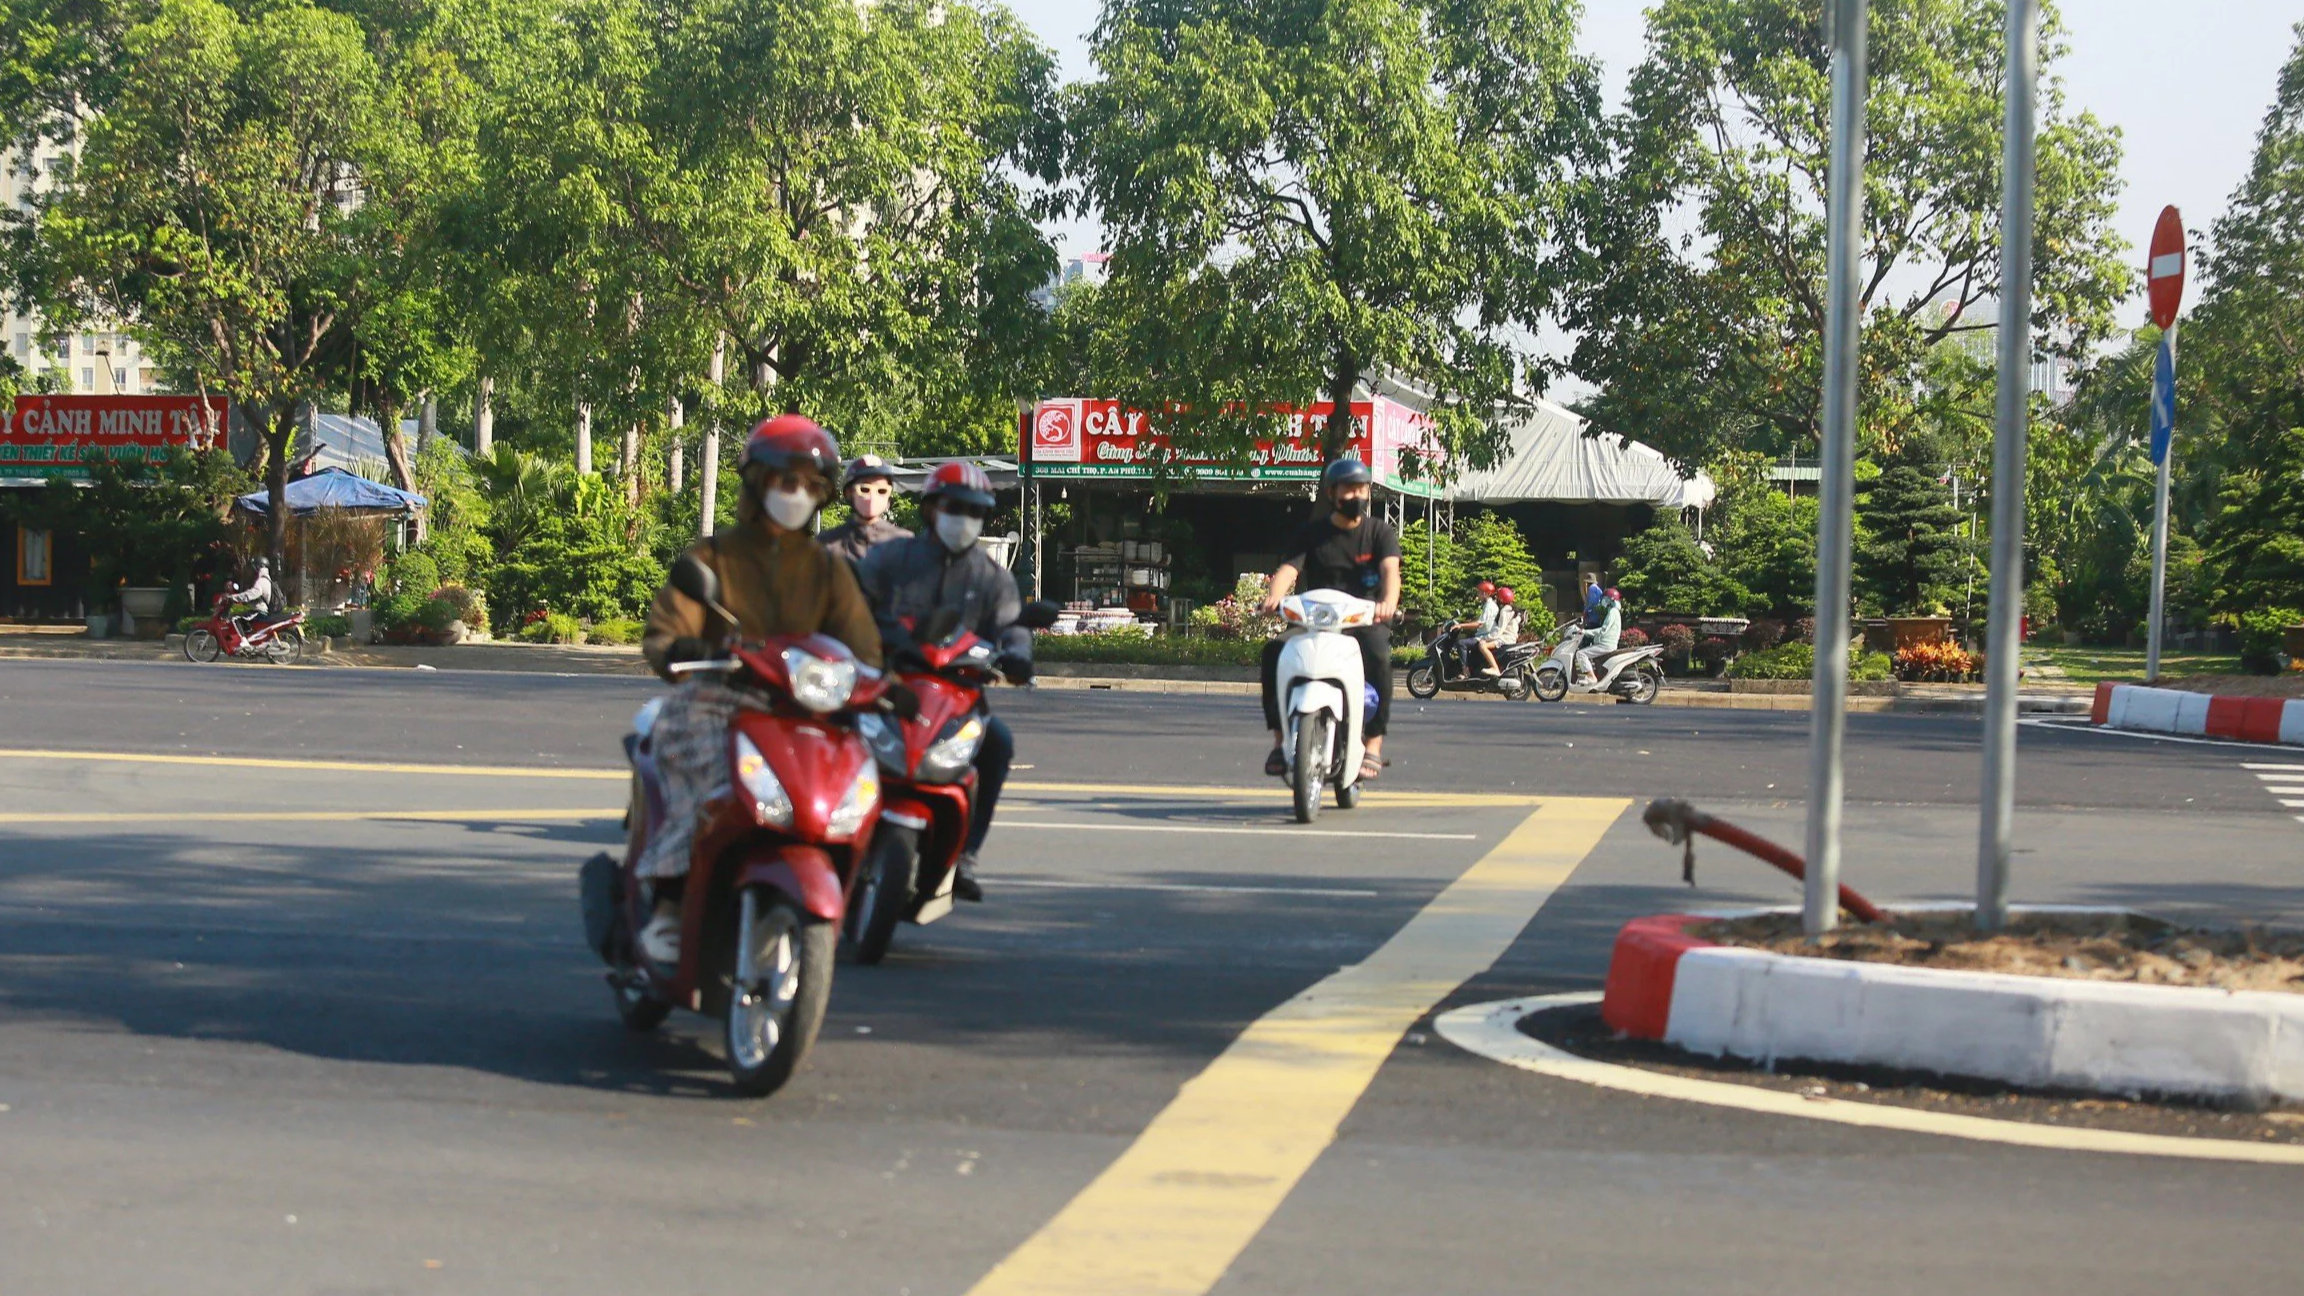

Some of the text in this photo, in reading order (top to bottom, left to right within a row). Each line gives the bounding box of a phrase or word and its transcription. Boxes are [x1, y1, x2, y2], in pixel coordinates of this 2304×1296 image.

[23, 400, 92, 434] CẢNH
[98, 410, 164, 434] MINH
[1085, 406, 1143, 435] CÂY
[58, 438, 78, 461] KẾ
[1097, 441, 1134, 463] Cùng
[1066, 465, 1080, 474] CHÍ
[1107, 466, 1118, 474] AN
